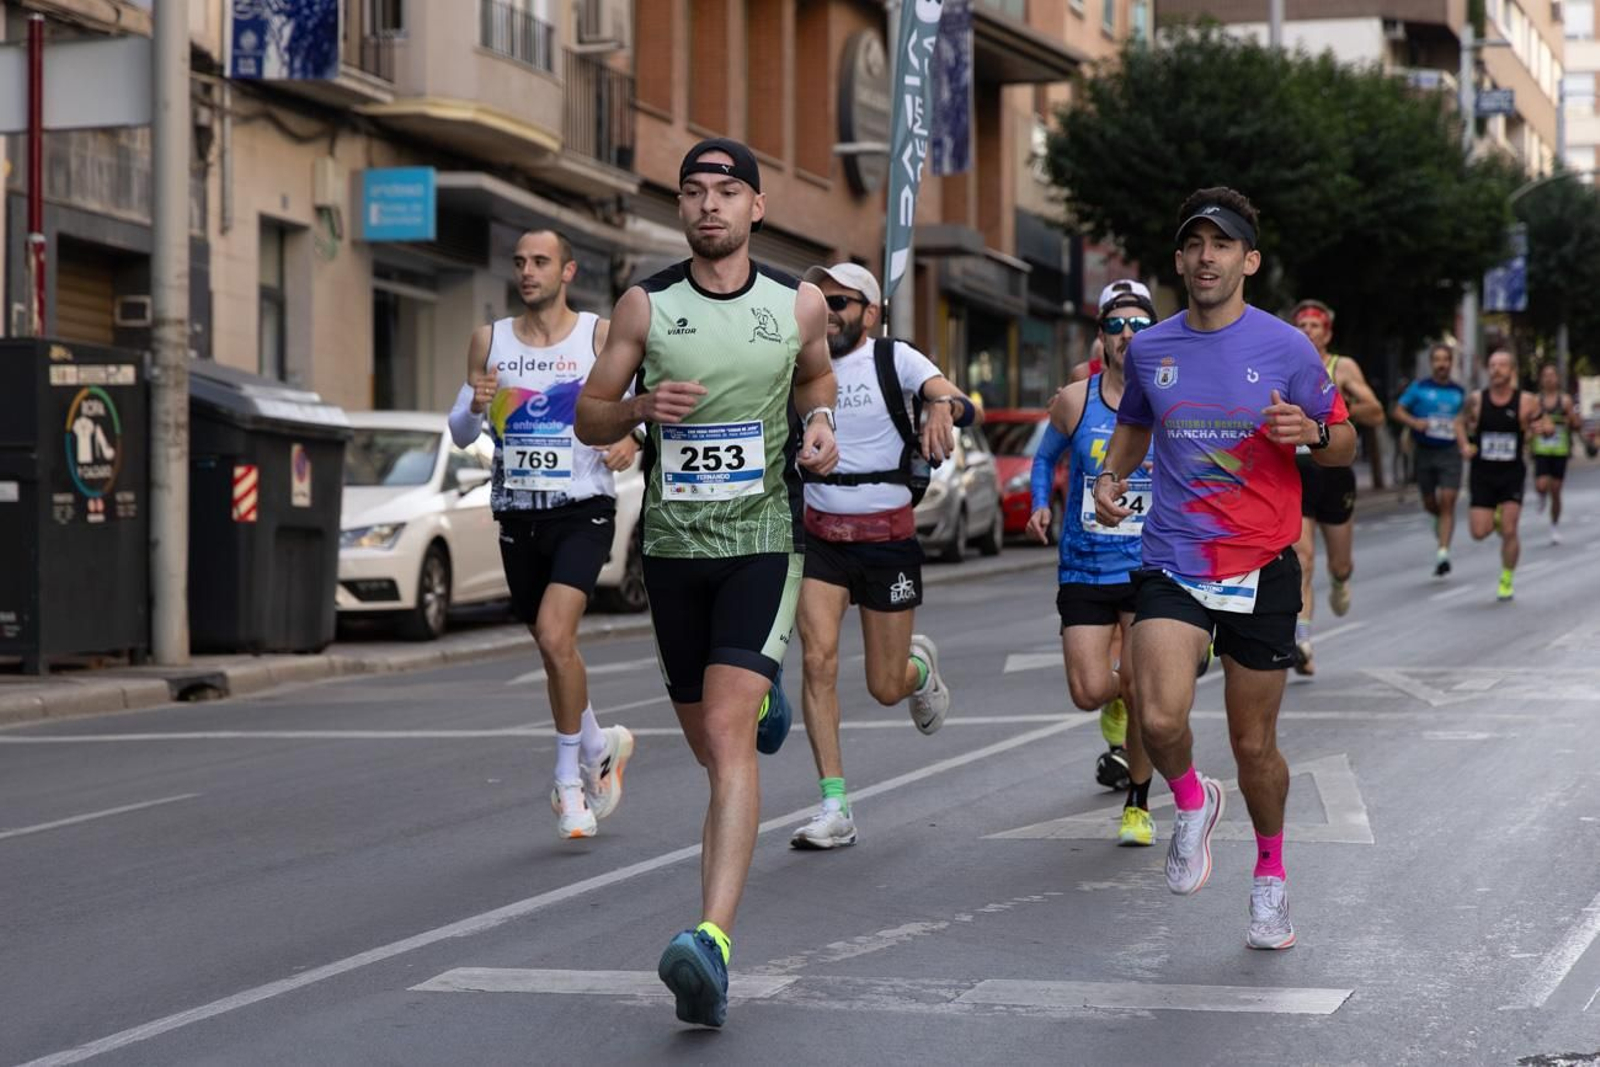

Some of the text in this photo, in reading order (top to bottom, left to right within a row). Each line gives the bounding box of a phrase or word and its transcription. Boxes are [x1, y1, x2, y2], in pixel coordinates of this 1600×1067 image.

[496, 355, 577, 377] calderón
[1167, 429, 1218, 439] MANCHA
[516, 450, 558, 469] 769
[680, 445, 746, 472] 253
[696, 473, 731, 481] FERNANDO
